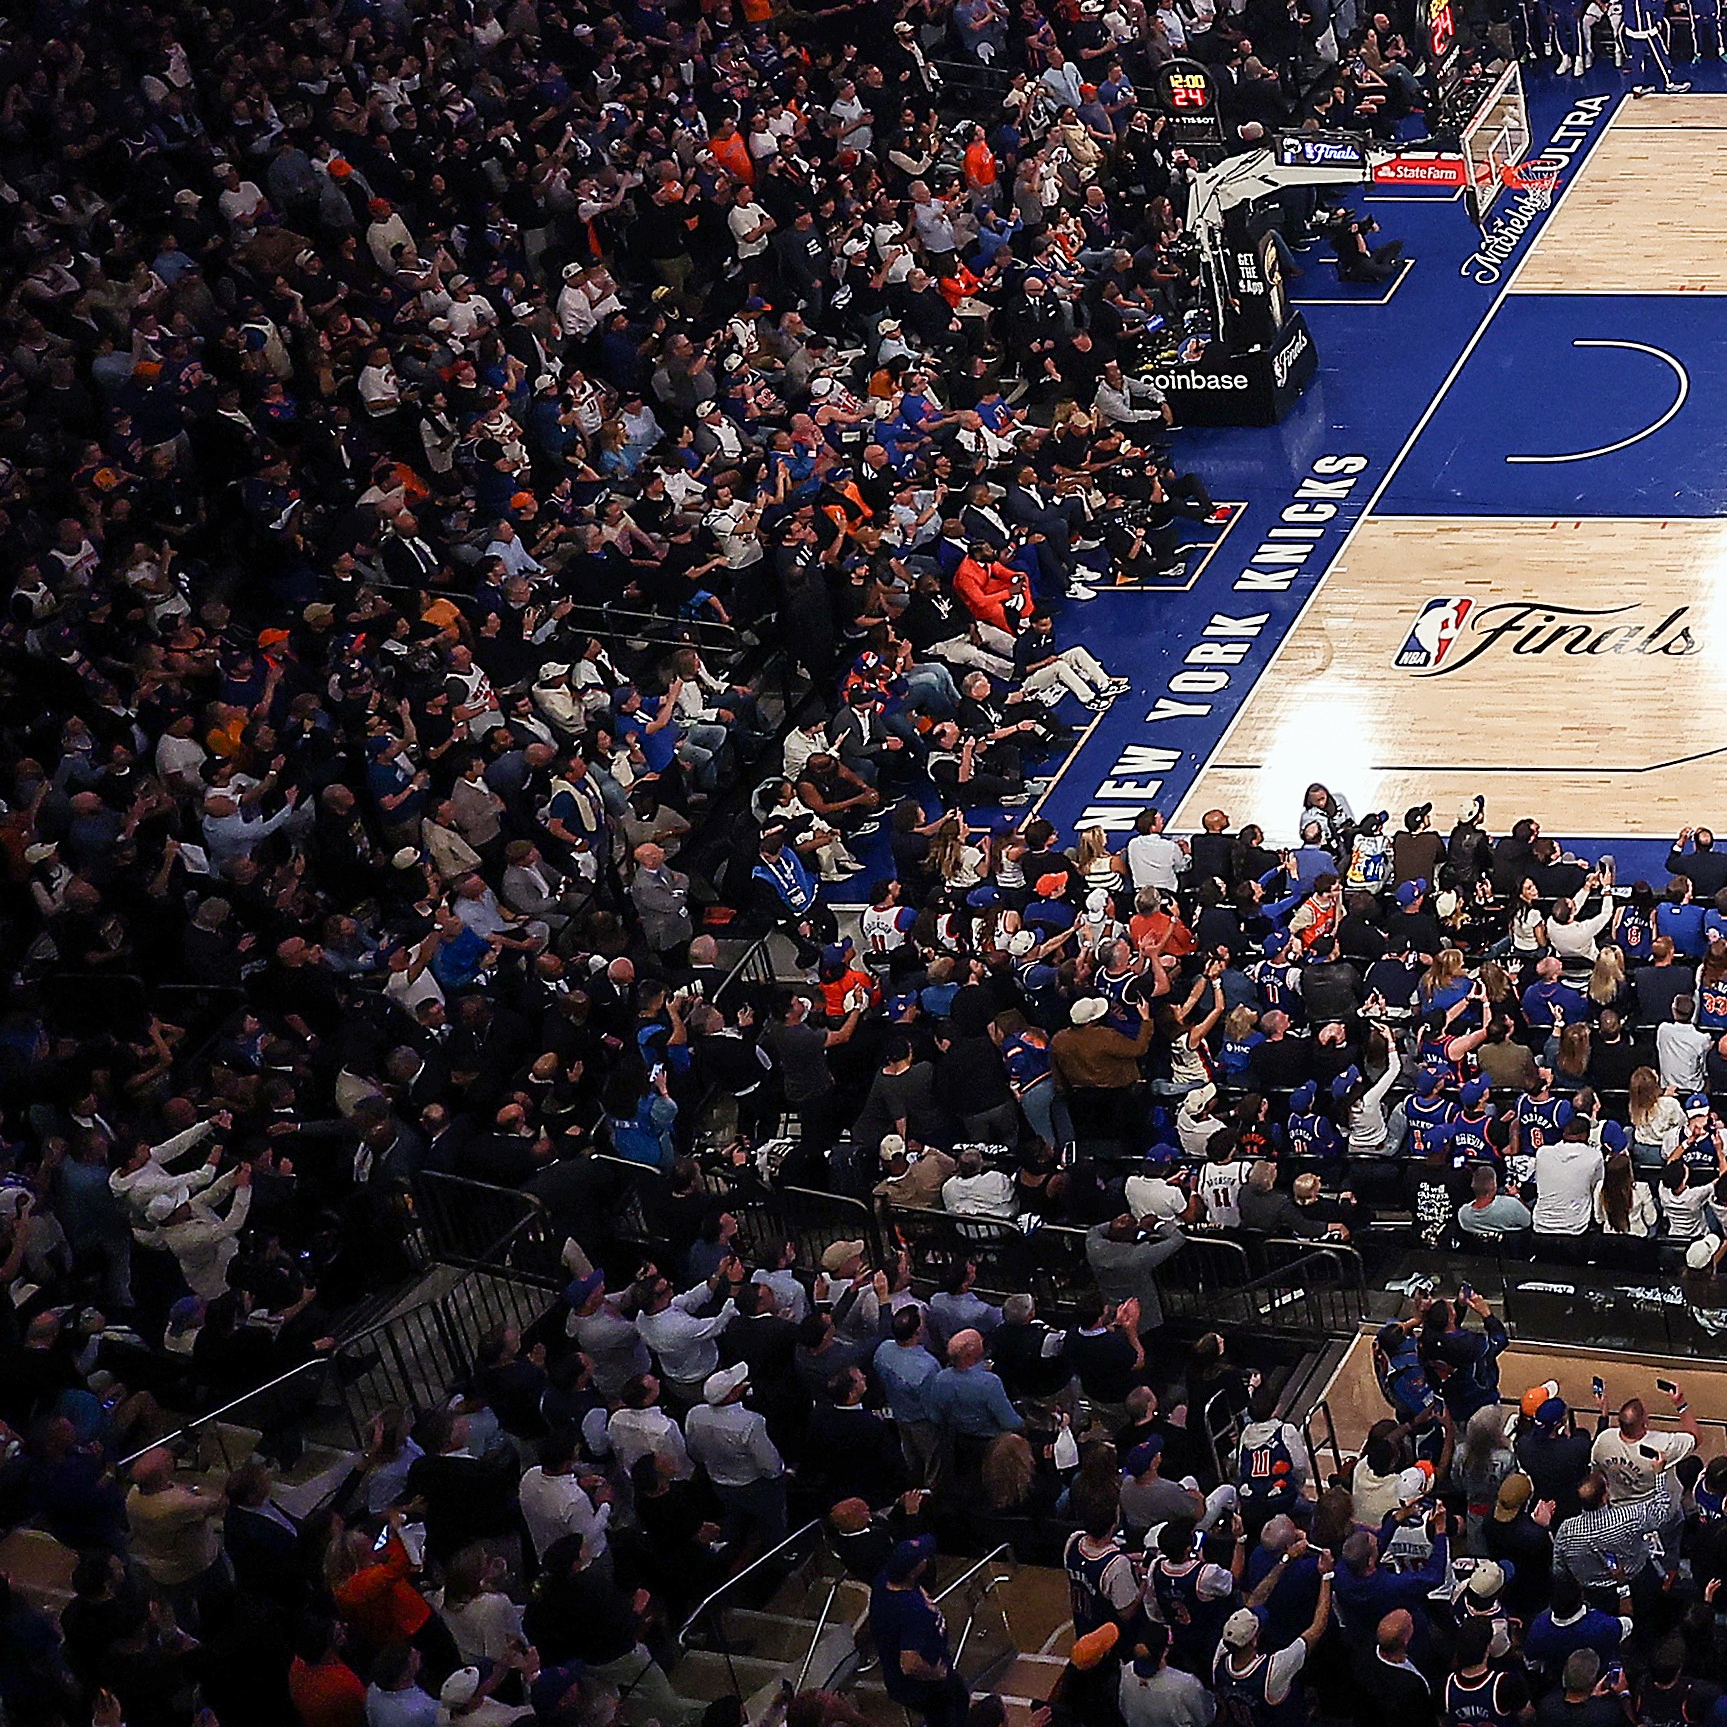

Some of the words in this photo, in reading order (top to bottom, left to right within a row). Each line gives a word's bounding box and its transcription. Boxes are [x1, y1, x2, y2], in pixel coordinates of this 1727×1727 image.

[1170, 75, 1205, 89] 12:00
[1173, 89, 1203, 106] 24
[1532, 95, 1610, 171] ULTRA
[1314, 144, 1359, 162] Finals
[1281, 329, 1307, 387] Finals
[1140, 370, 1248, 389] coinbase
[1073, 744, 1181, 830] NEW
[1146, 612, 1270, 719] YORK
[1235, 453, 1369, 593] KNICKS
[1409, 599, 1703, 677] Finals
[1398, 651, 1426, 666] NBA
[1266, 984, 1279, 1004] 11
[1213, 1189, 1231, 1207] 11
[1252, 1450, 1270, 1477] 11
